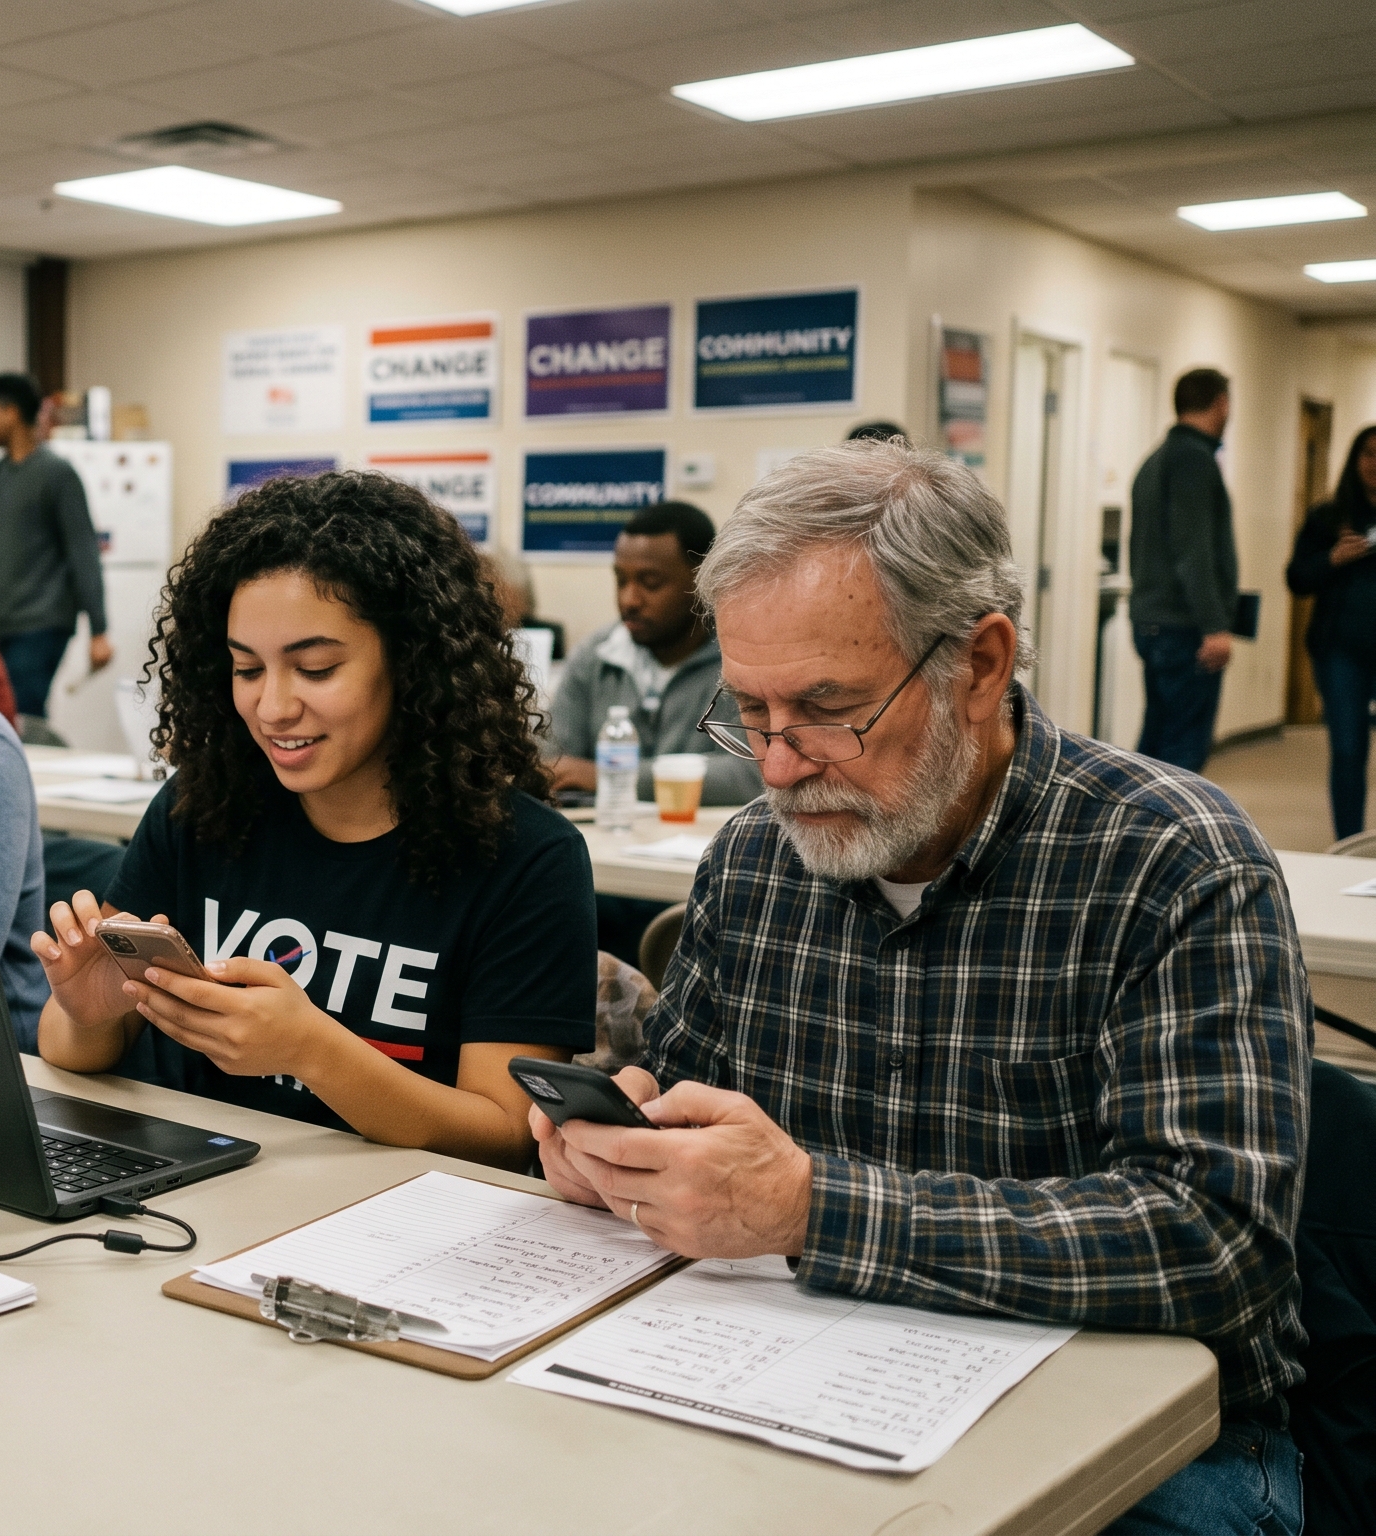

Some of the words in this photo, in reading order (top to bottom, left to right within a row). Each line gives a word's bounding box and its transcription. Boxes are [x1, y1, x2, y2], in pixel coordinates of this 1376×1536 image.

[529, 337, 665, 377] CHANGE
[699, 325, 852, 361] COMMUNITY
[371, 352, 487, 381] CHANGE
[204, 897, 439, 1031] VOTE
